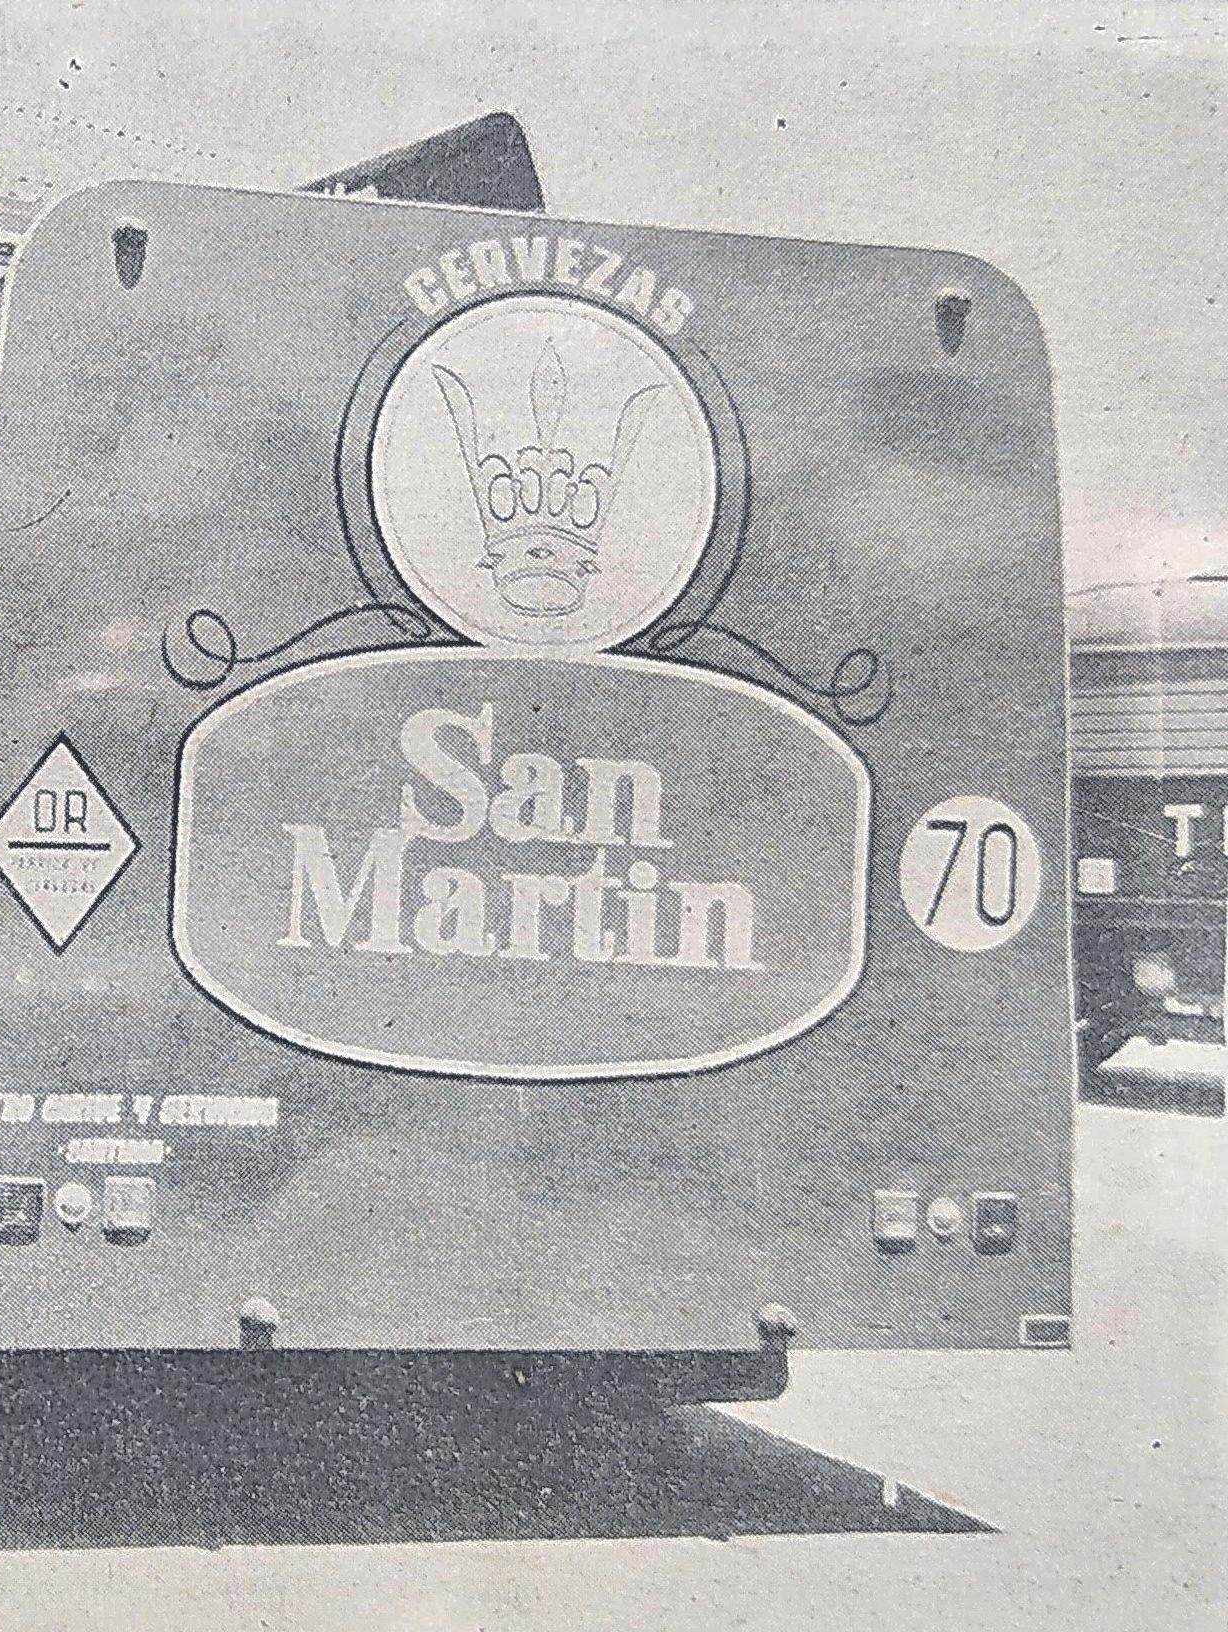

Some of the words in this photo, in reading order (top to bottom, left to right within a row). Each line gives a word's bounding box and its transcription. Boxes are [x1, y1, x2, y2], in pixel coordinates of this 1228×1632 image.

[404, 236, 694, 335] CERVEZAS
[401, 703, 673, 848] San
[276, 822, 766, 970] Martin
[924, 820, 1018, 927] 70
